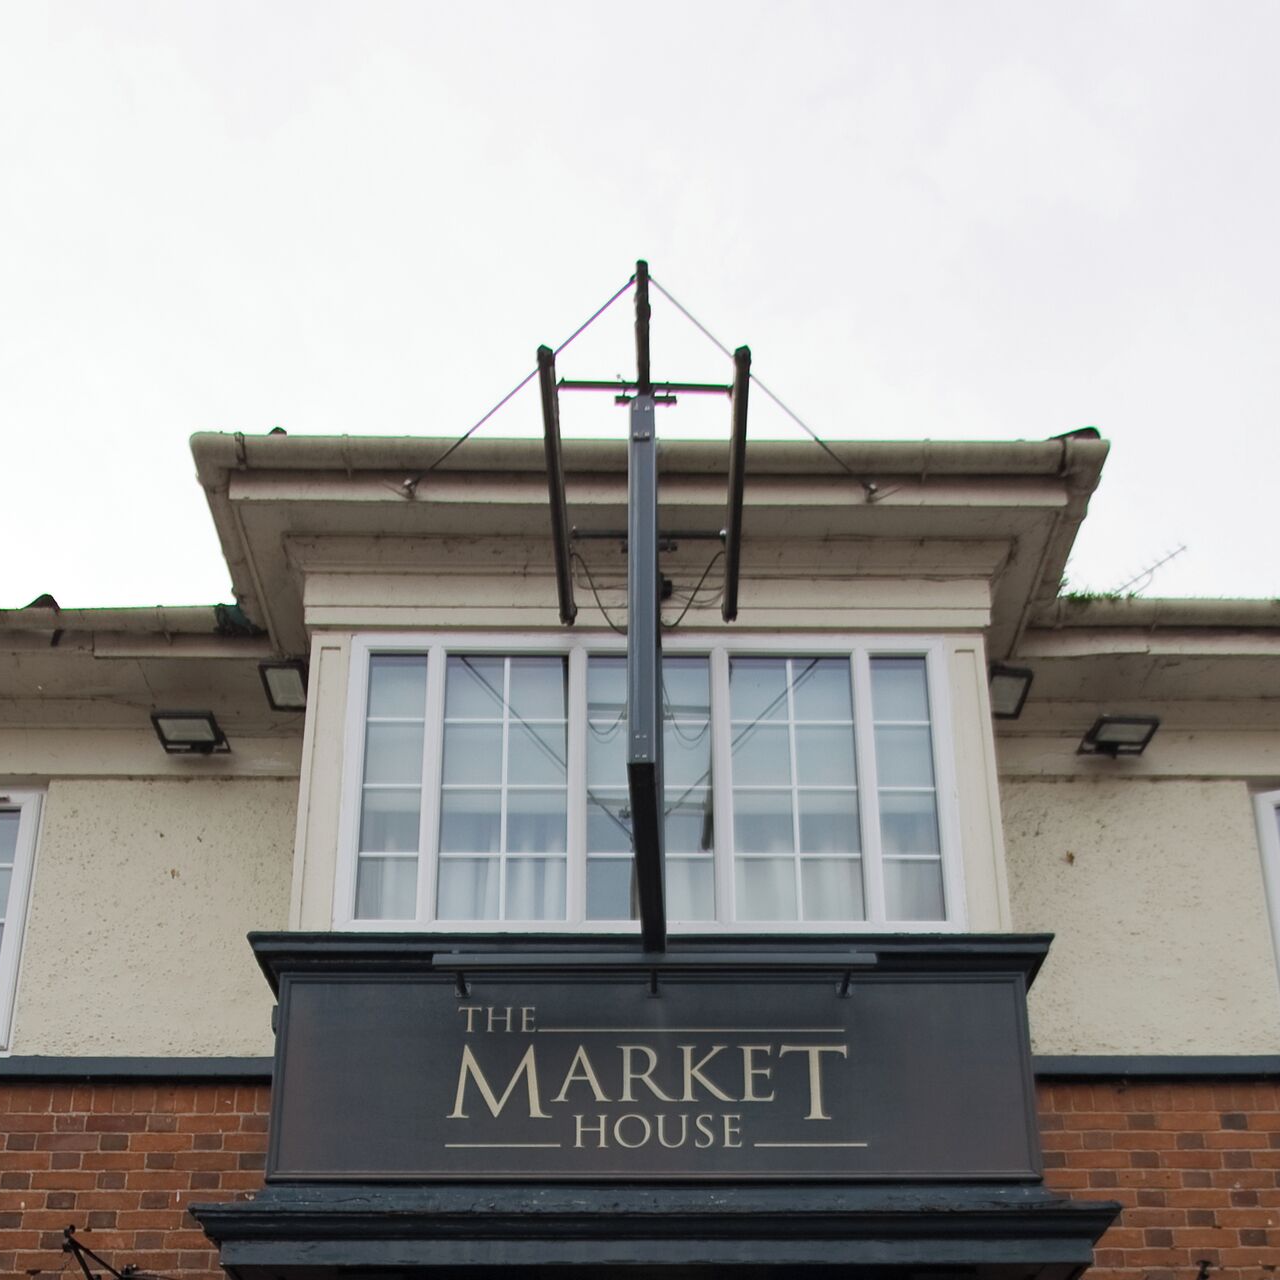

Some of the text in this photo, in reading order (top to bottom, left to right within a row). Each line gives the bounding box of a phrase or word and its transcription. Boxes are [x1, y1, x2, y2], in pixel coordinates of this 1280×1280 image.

[458, 1006, 538, 1033] THE
[446, 1044, 848, 1121] MARKET
[572, 1114, 743, 1148] HOUSE
